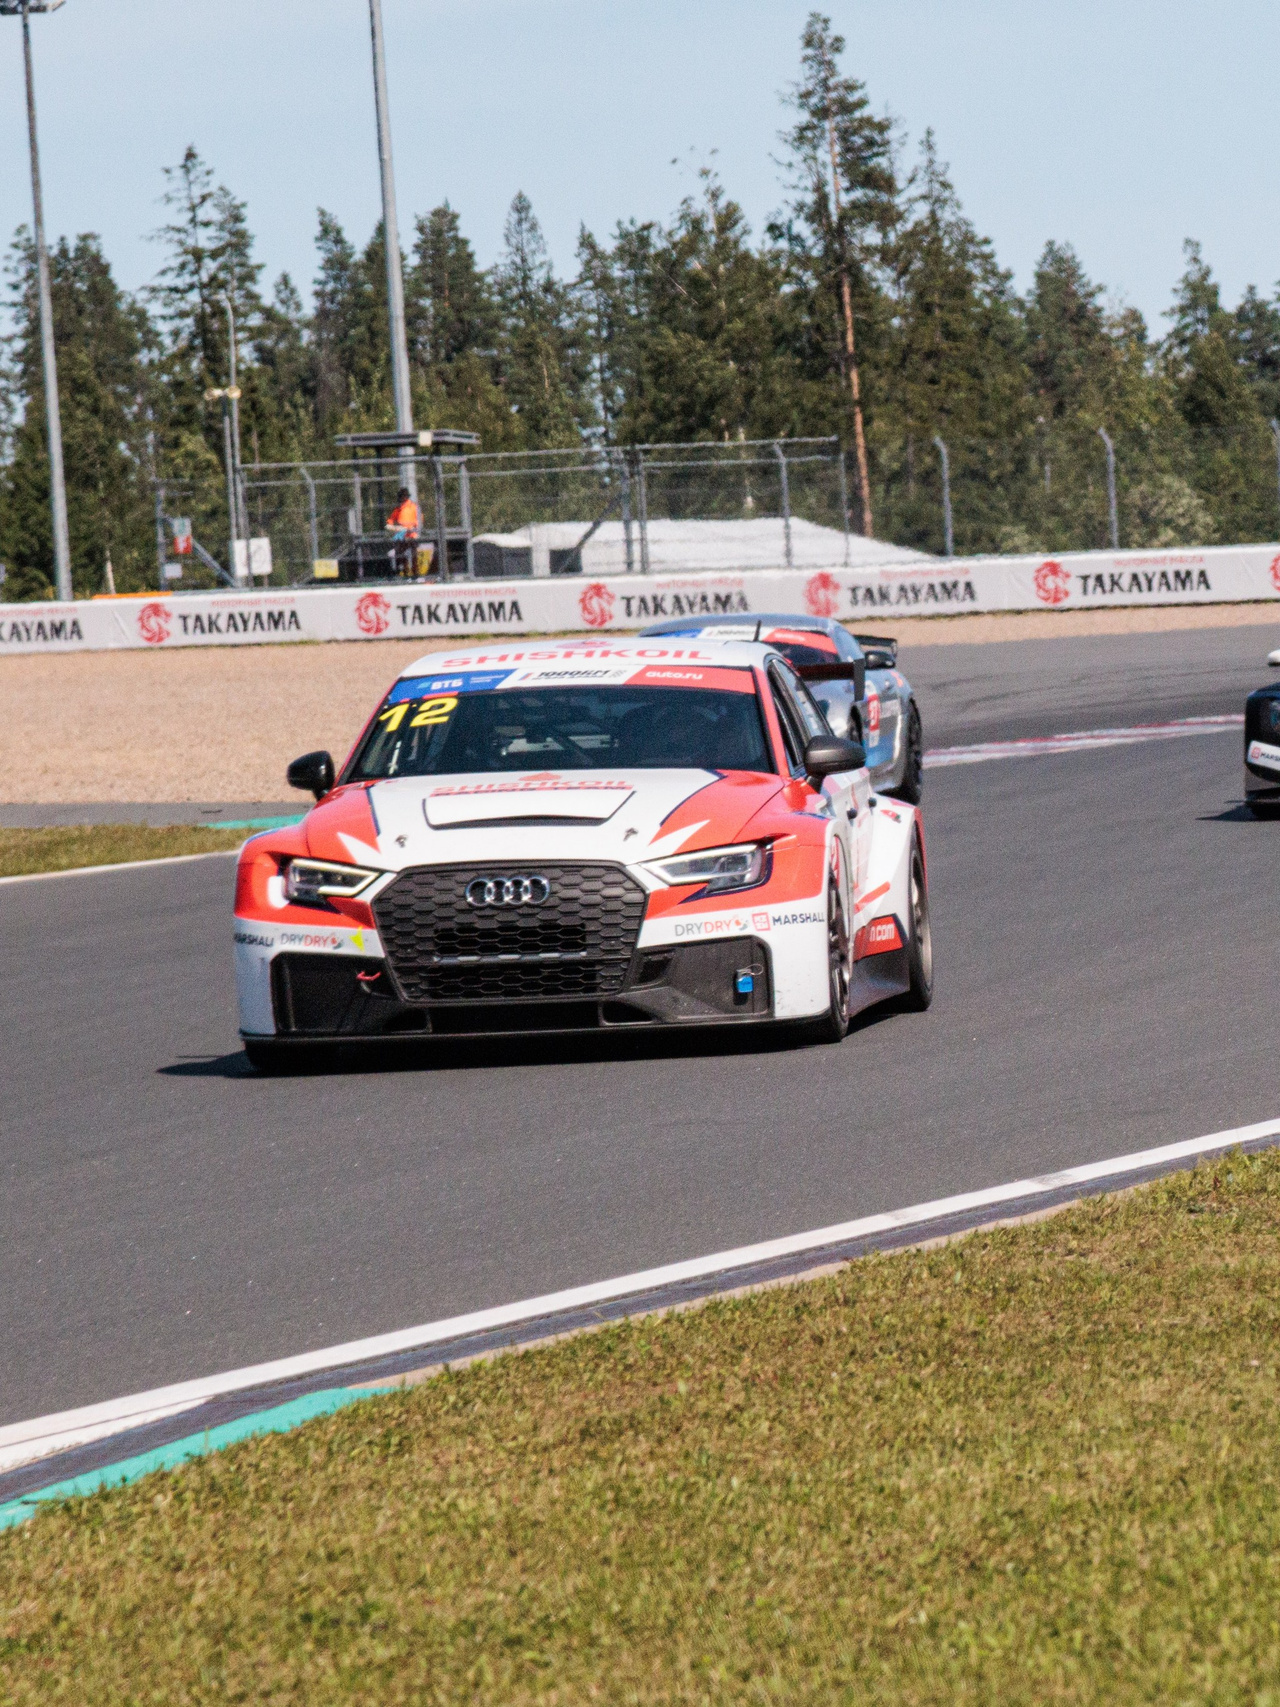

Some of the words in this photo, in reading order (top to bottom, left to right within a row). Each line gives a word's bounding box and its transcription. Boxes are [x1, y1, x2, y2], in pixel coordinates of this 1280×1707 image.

[848, 580, 977, 606] TAKAYAMA
[1076, 569, 1212, 595] TAKAYAMA
[397, 600, 523, 626] TAKAYAMA
[621, 590, 749, 618] TAKAYAMA
[179, 610, 301, 635] TAKAYAMA
[441, 649, 713, 668] SHISHKOIL
[645, 671, 704, 680] auto.ru
[379, 697, 459, 733] 12
[772, 911, 826, 926] MARSHALL
